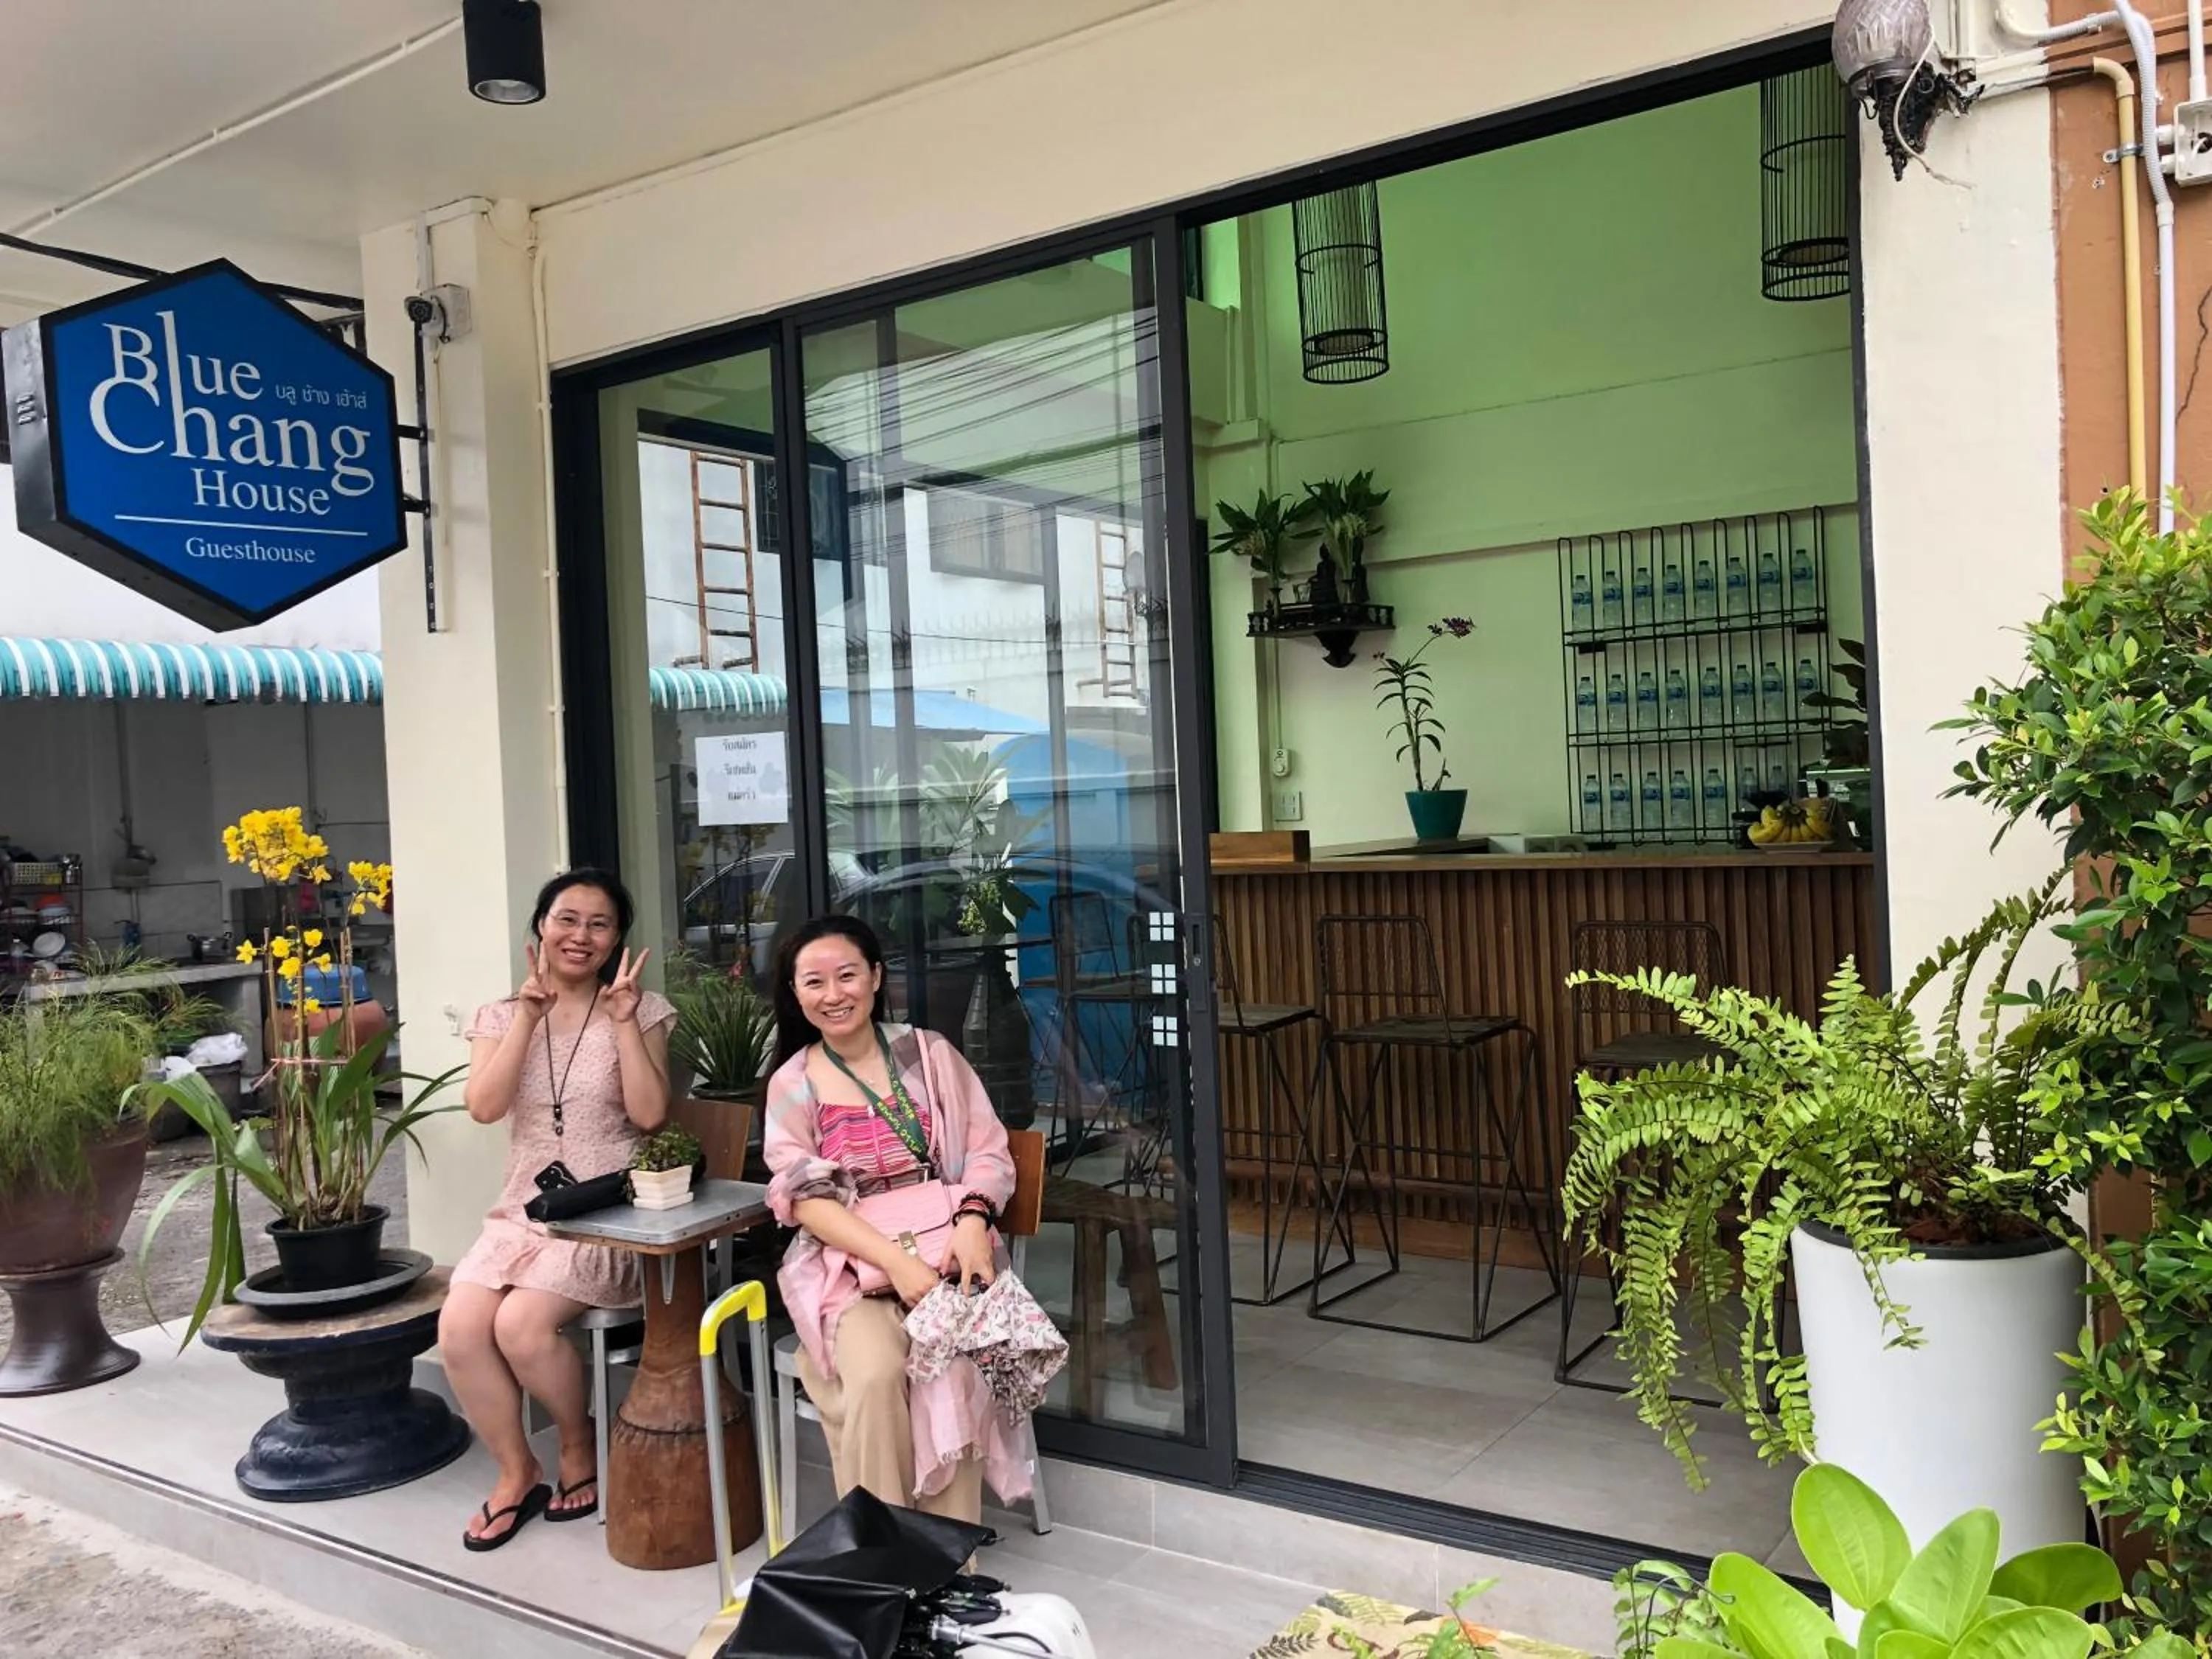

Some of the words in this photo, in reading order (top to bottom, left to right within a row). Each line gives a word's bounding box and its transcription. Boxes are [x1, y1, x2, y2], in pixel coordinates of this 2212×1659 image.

[103, 310, 263, 400] Blue
[275, 383, 296, 406] บลู
[302, 384, 330, 405] ช้าง
[89, 377, 375, 496] Chang
[191, 467, 331, 515] House
[186, 537, 316, 563] Guesthouse
